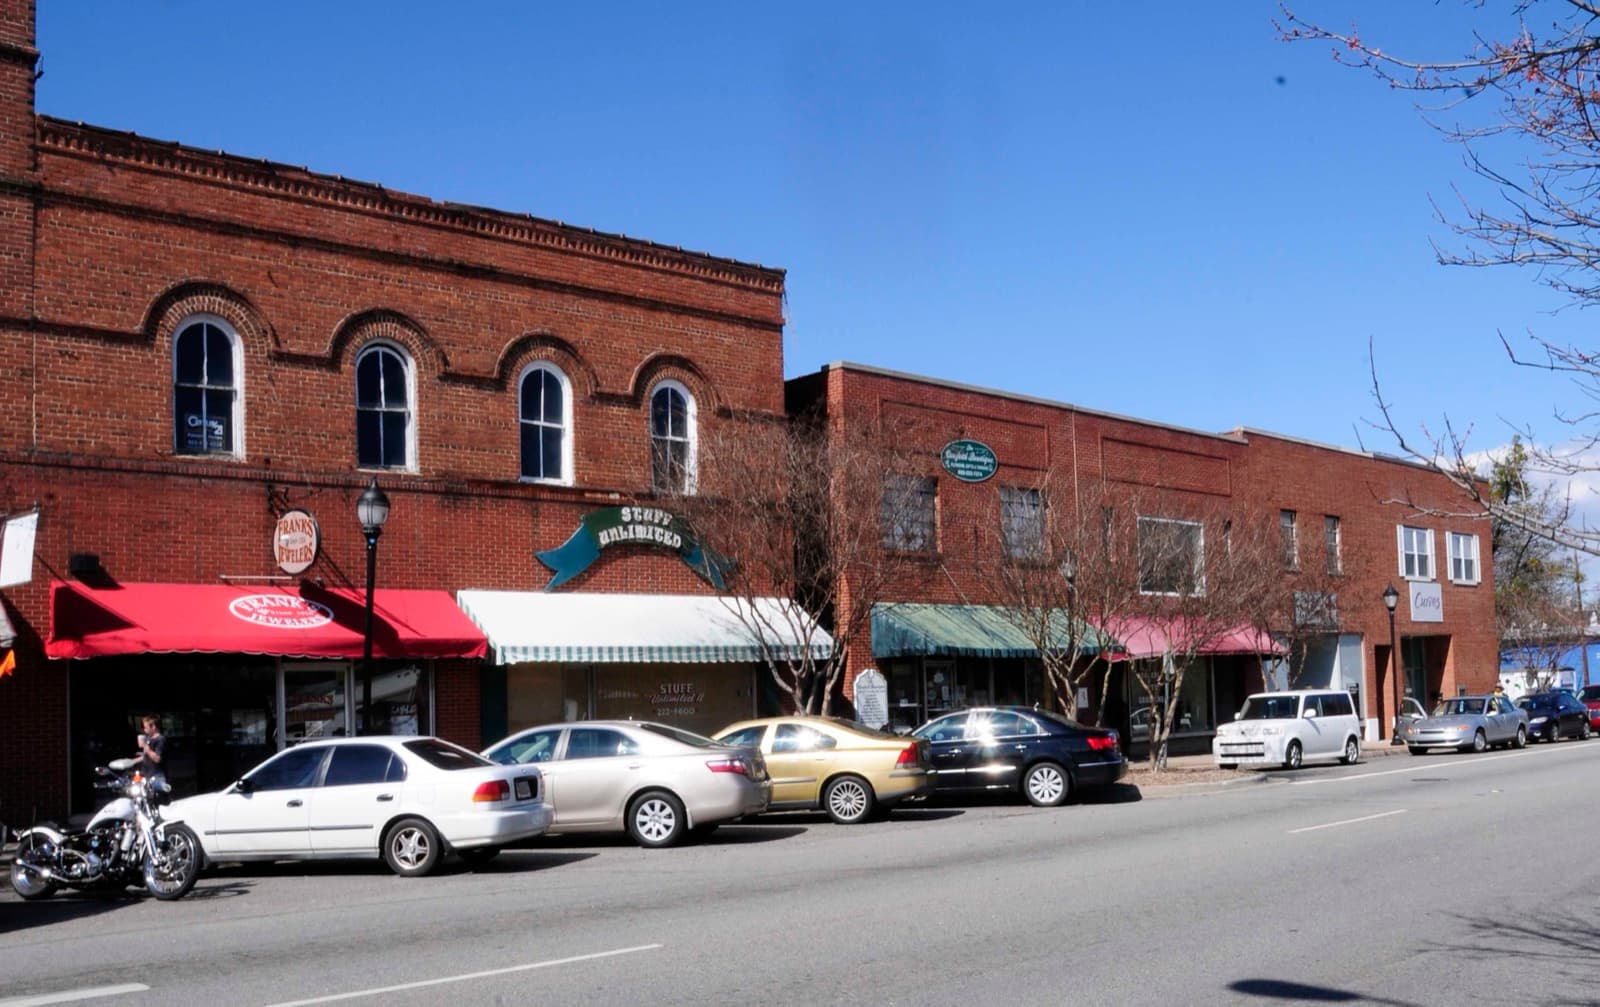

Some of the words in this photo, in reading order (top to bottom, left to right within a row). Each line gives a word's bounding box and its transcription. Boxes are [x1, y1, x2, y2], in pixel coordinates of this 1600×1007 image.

[621, 506, 673, 526] STUFF
[598, 524, 682, 548] UNLIMITED
[278, 542, 314, 565] JEWELERS
[248, 611, 329, 627] JEWELERS
[659, 683, 693, 695] STUFF
